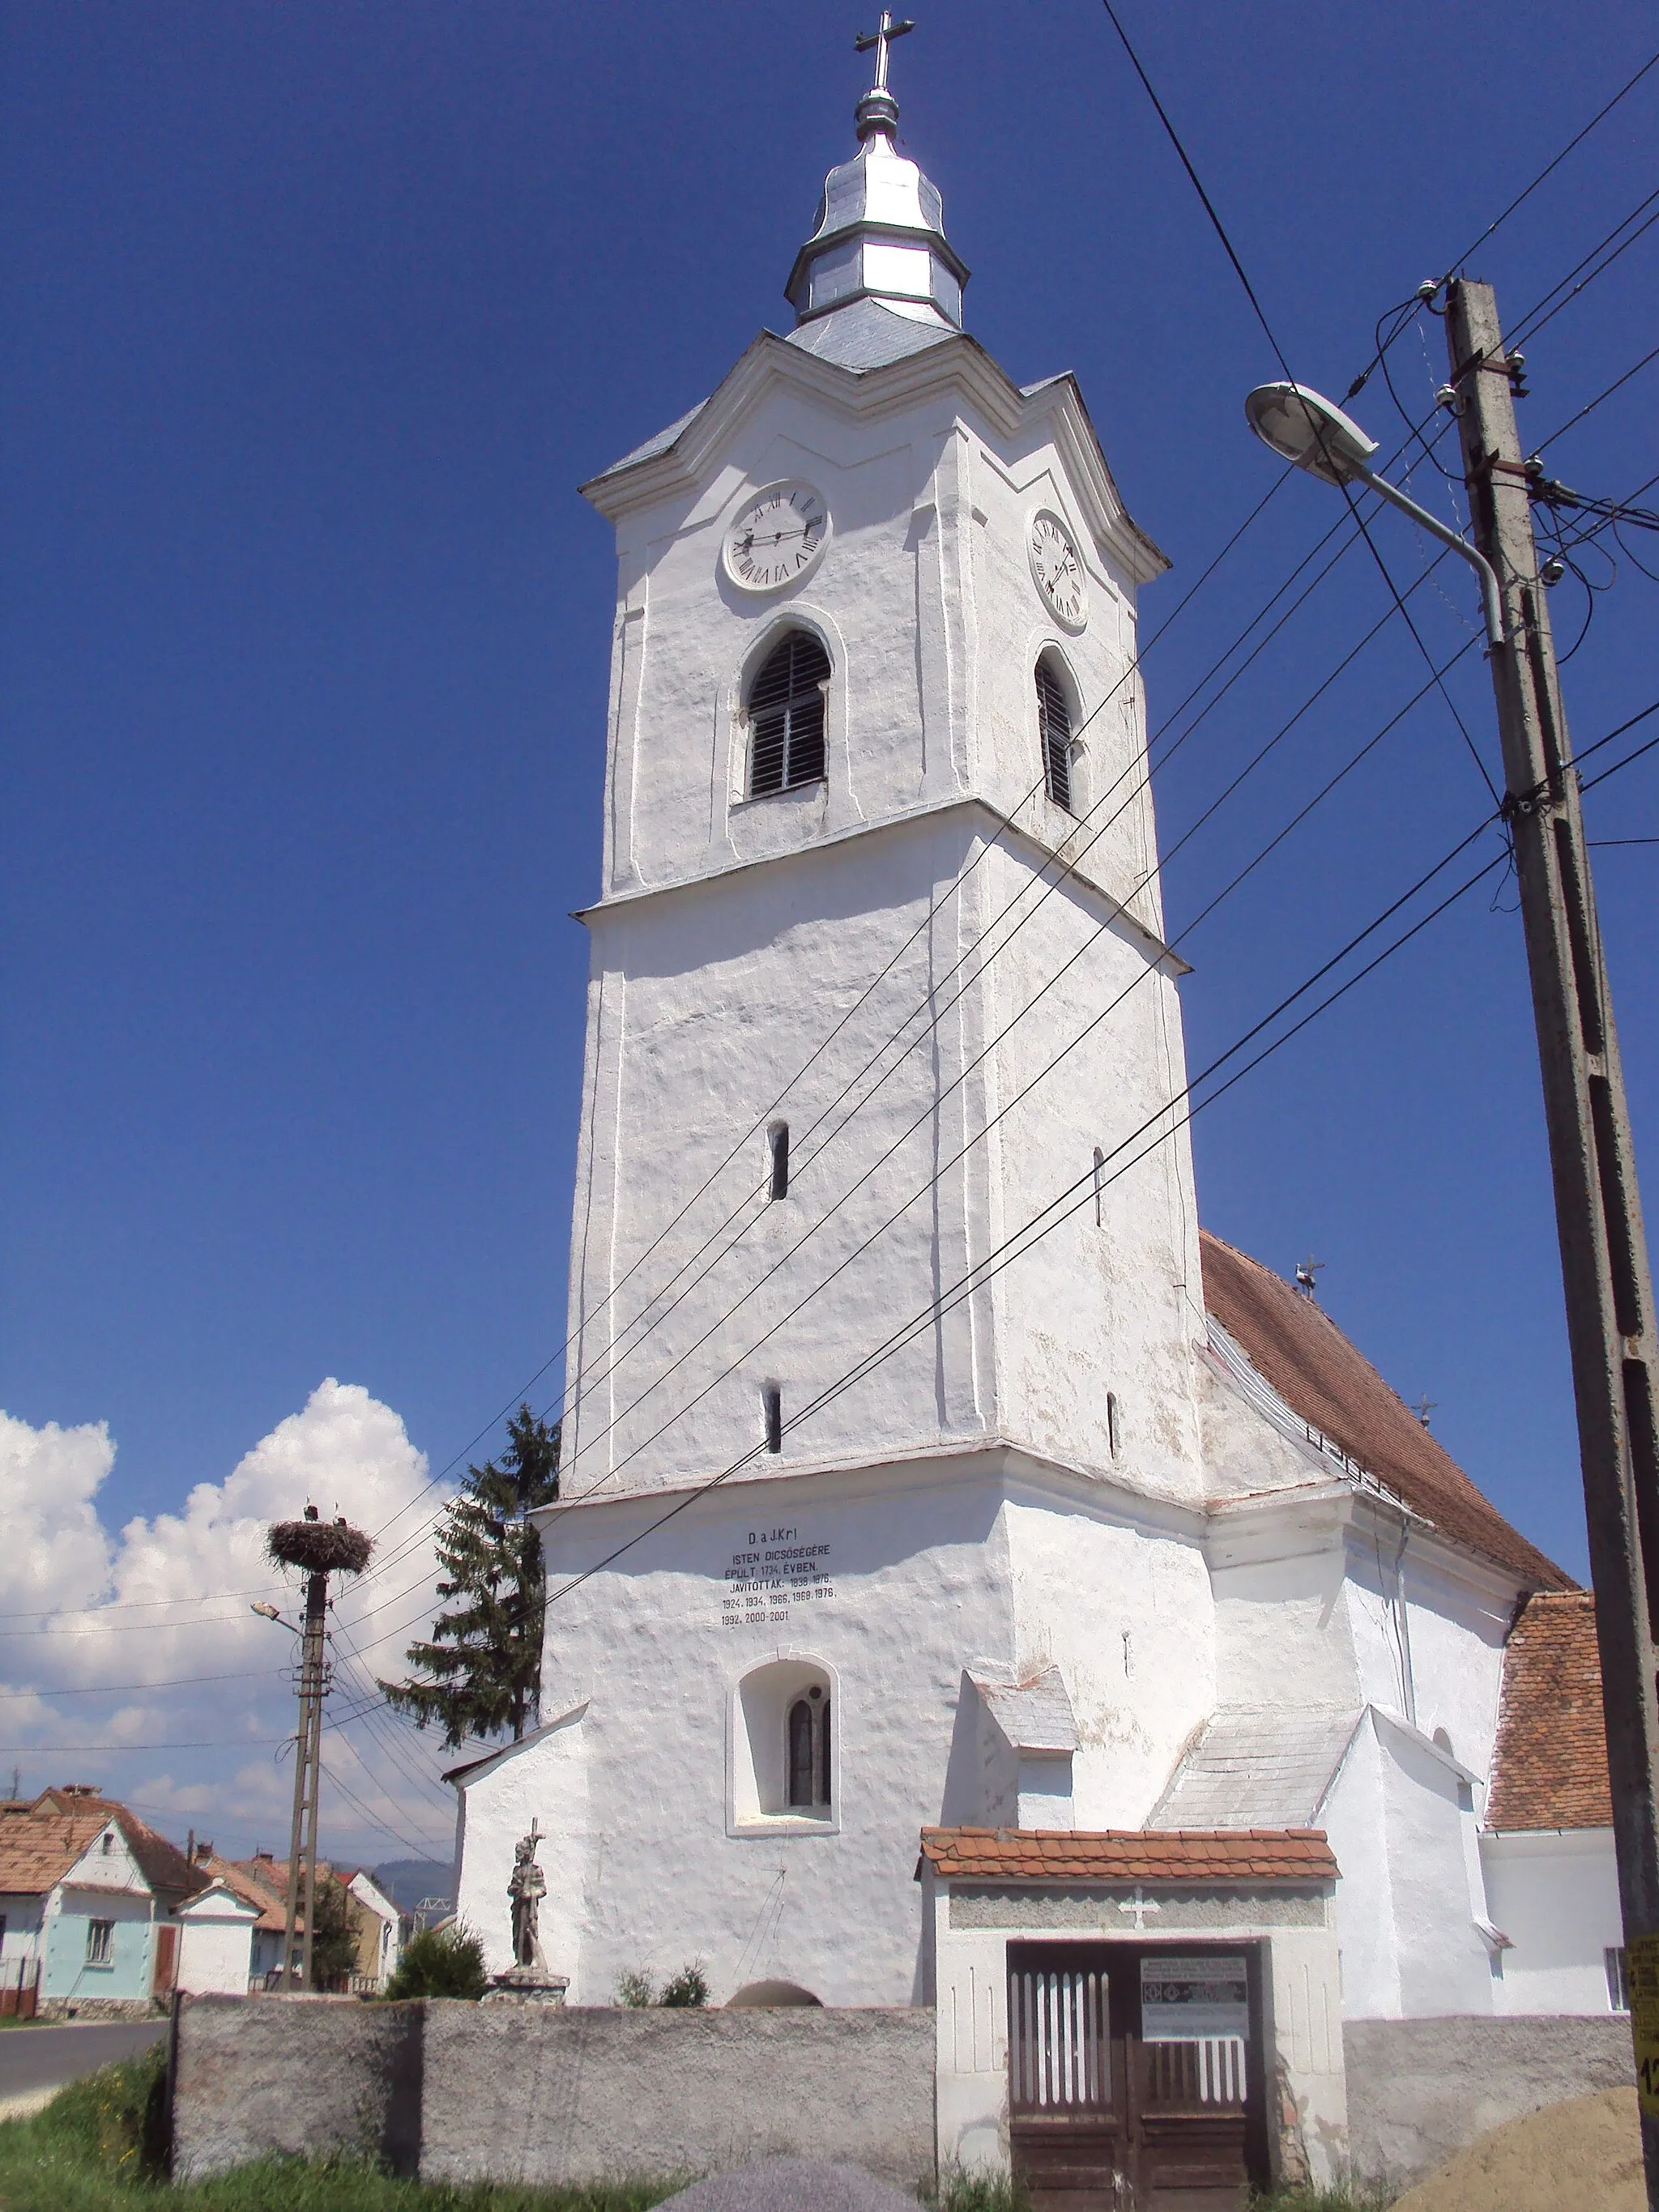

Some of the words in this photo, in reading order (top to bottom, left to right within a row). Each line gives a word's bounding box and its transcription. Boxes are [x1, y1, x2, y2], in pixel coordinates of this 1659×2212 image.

[795, 553, 808, 569] V
[761, 1533, 767, 1543] a
[732, 1553, 760, 1565] ISTEN
[783, 1562, 818, 1575] ÉVBEN.
